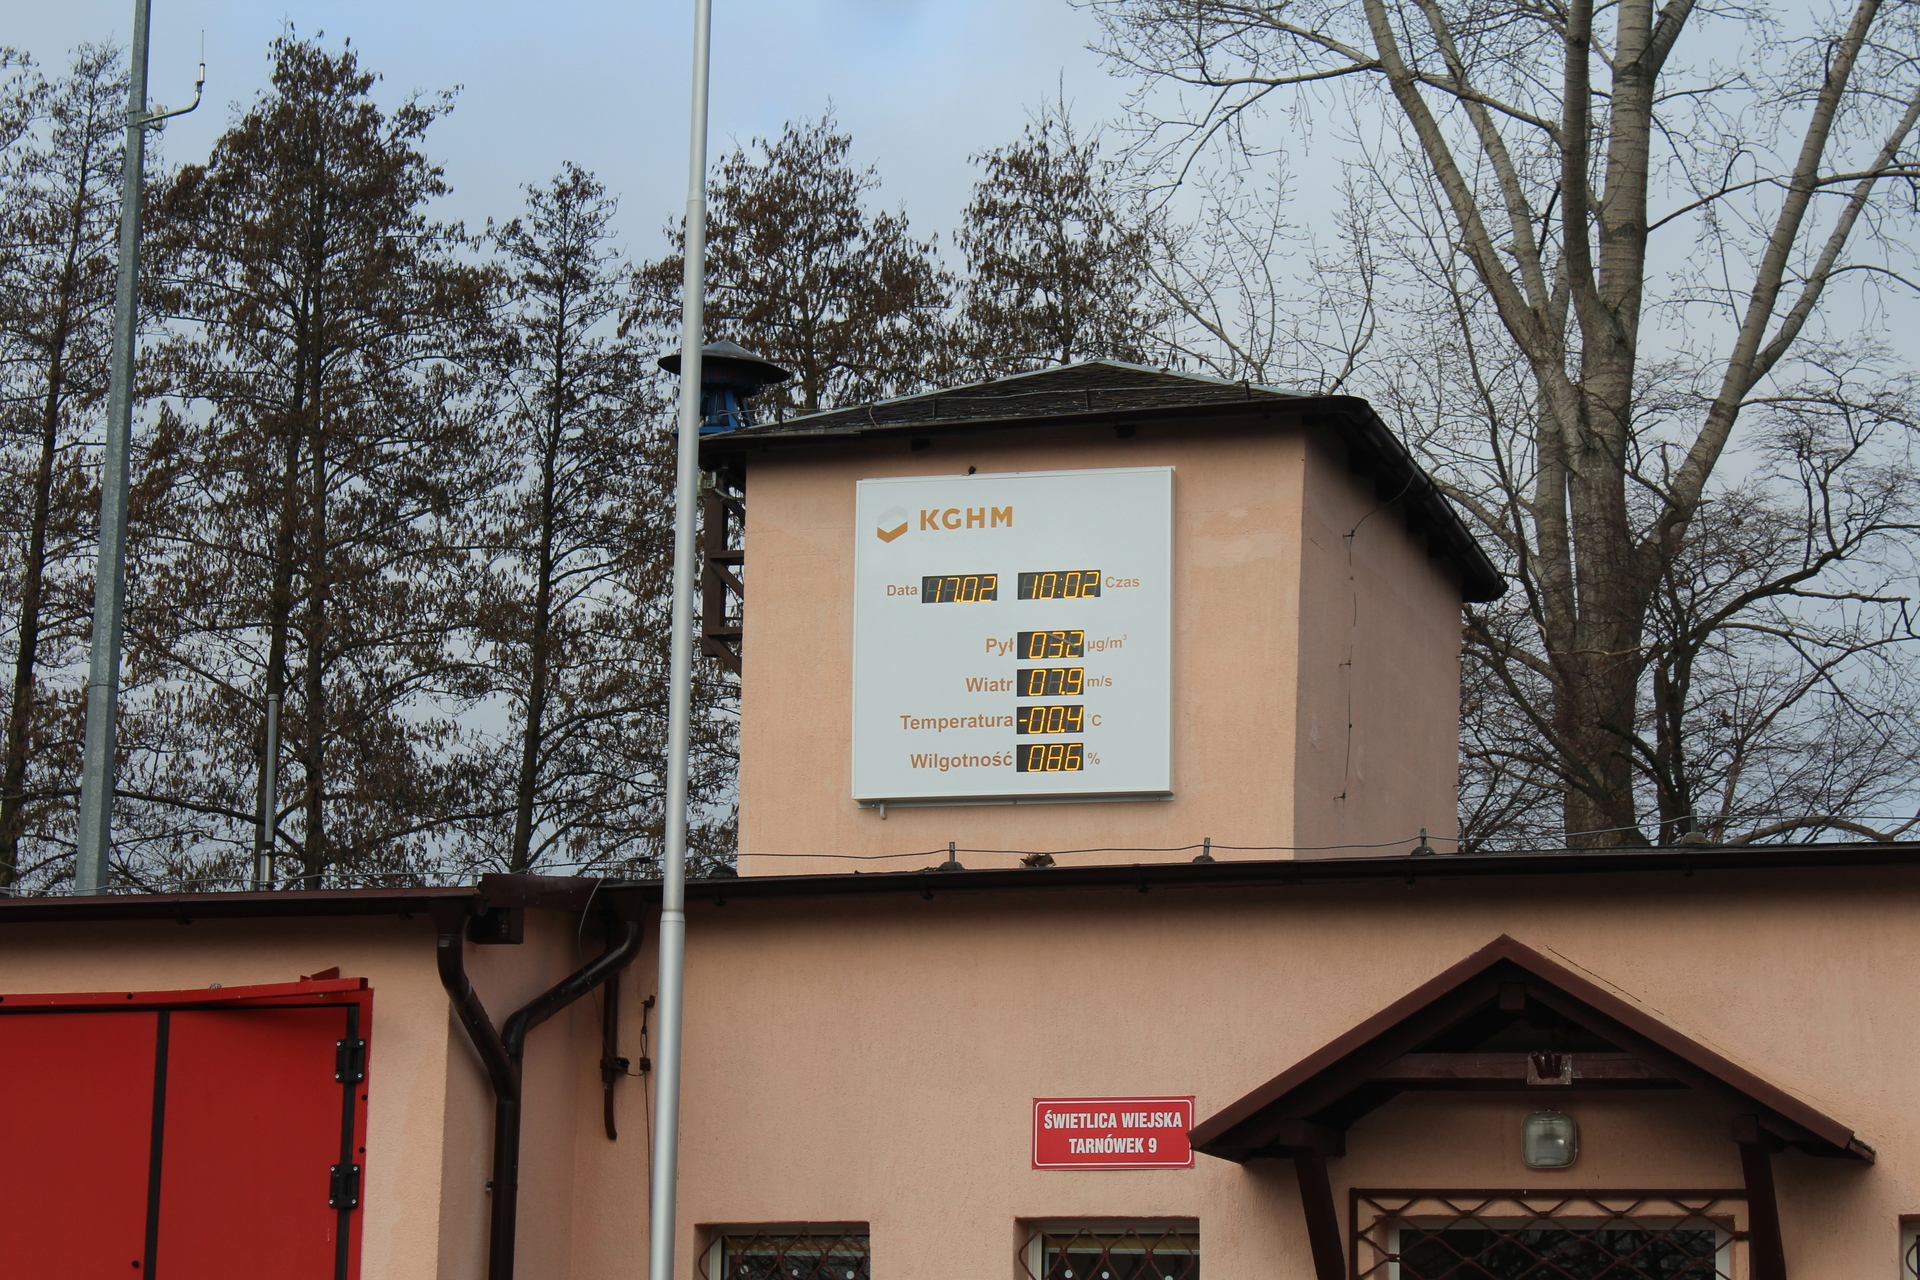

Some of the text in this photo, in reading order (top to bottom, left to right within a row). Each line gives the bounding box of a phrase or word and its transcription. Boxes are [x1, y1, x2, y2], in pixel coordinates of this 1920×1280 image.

[919, 506, 1014, 531] KGHM
[887, 584, 918, 597] Data
[1032, 571, 1140, 600] 10:02 Czas
[985, 638, 1014, 656] Pył
[1028, 632, 1084, 659] 032
[966, 668, 1113, 696] Wiatr 07.9 m/s
[900, 713, 1014, 733] Temperatura
[1018, 706, 1084, 734] -00.4
[910, 744, 1101, 772] Wilgotność 086 %
[1043, 1109, 1183, 1129] ŚWIETLICA WIEJSKA
[1068, 1133, 1158, 1154] TARNÓWEK 9
